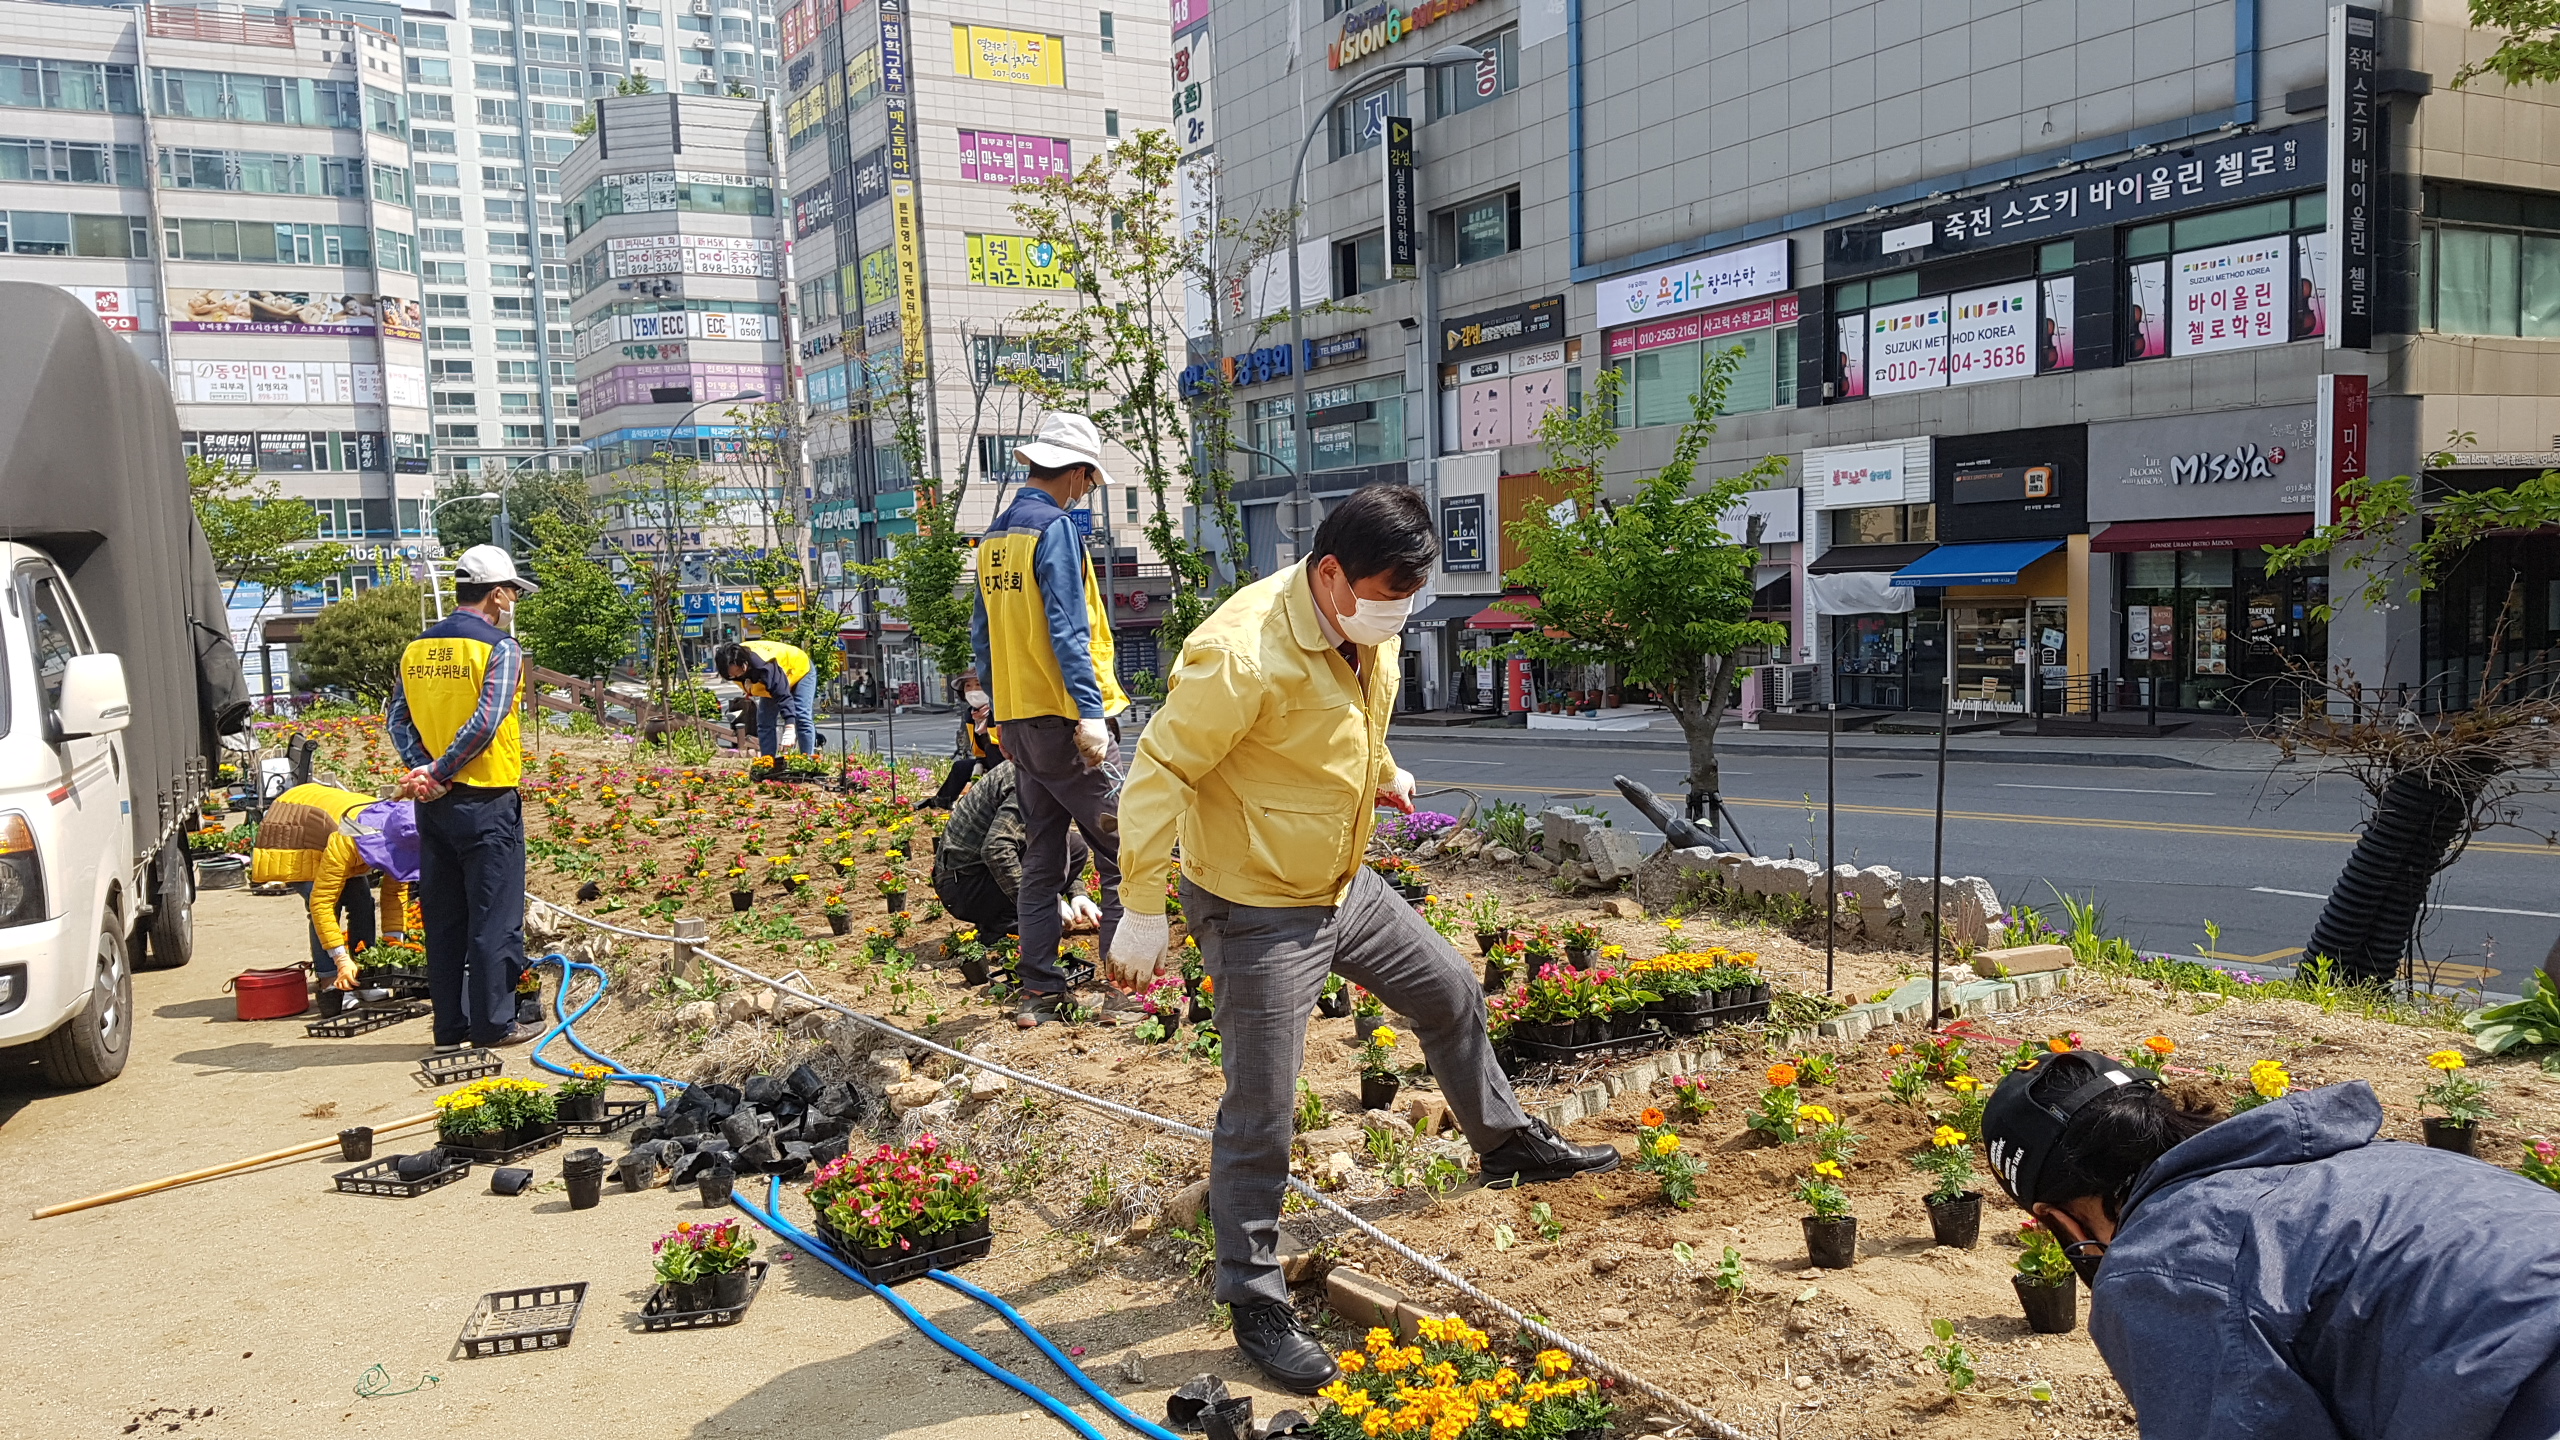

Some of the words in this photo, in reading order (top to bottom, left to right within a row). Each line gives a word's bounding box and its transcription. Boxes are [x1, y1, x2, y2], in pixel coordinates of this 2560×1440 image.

[2349, 47, 2373, 72] 죽전
[2351, 77, 2368, 151] 스즈키
[2283, 140, 2298, 171] 학원
[1944, 206, 1993, 242] 죽전
[2001, 187, 2078, 229] 스즈키
[2089, 160, 2205, 211] 바이올린
[2215, 145, 2277, 187] 첼로
[2350, 158, 2368, 256] 바이올린
[729, 252, 760, 265] 중국어
[1708, 266, 1756, 295] 창의수학
[2189, 275, 2215, 286] SUZUKI
[2215, 270, 2245, 281] METHOD
[2246, 266, 2271, 276] KOREA
[2188, 282, 2271, 315] 바이올린
[2349, 267, 2367, 316] 첼로
[633, 318, 659, 337] YBM
[662, 315, 684, 335] ECC
[707, 318, 725, 334] ECC
[2188, 311, 2272, 346] 첼로학원
[1885, 339, 1922, 356] SUZUKI
[1925, 331, 1975, 349] METHOD
[1978, 324, 2016, 341] KOREA
[215, 364, 287, 380] 동안미인
[1888, 344, 2026, 383] 010-7404-3636
[203, 434, 252, 448] 무에타이
[291, 442, 306, 450] GYM
[631, 533, 655, 547] IBK
[426, 647, 454, 662] 보정동
[407, 664, 471, 680] 주민자치위원회
